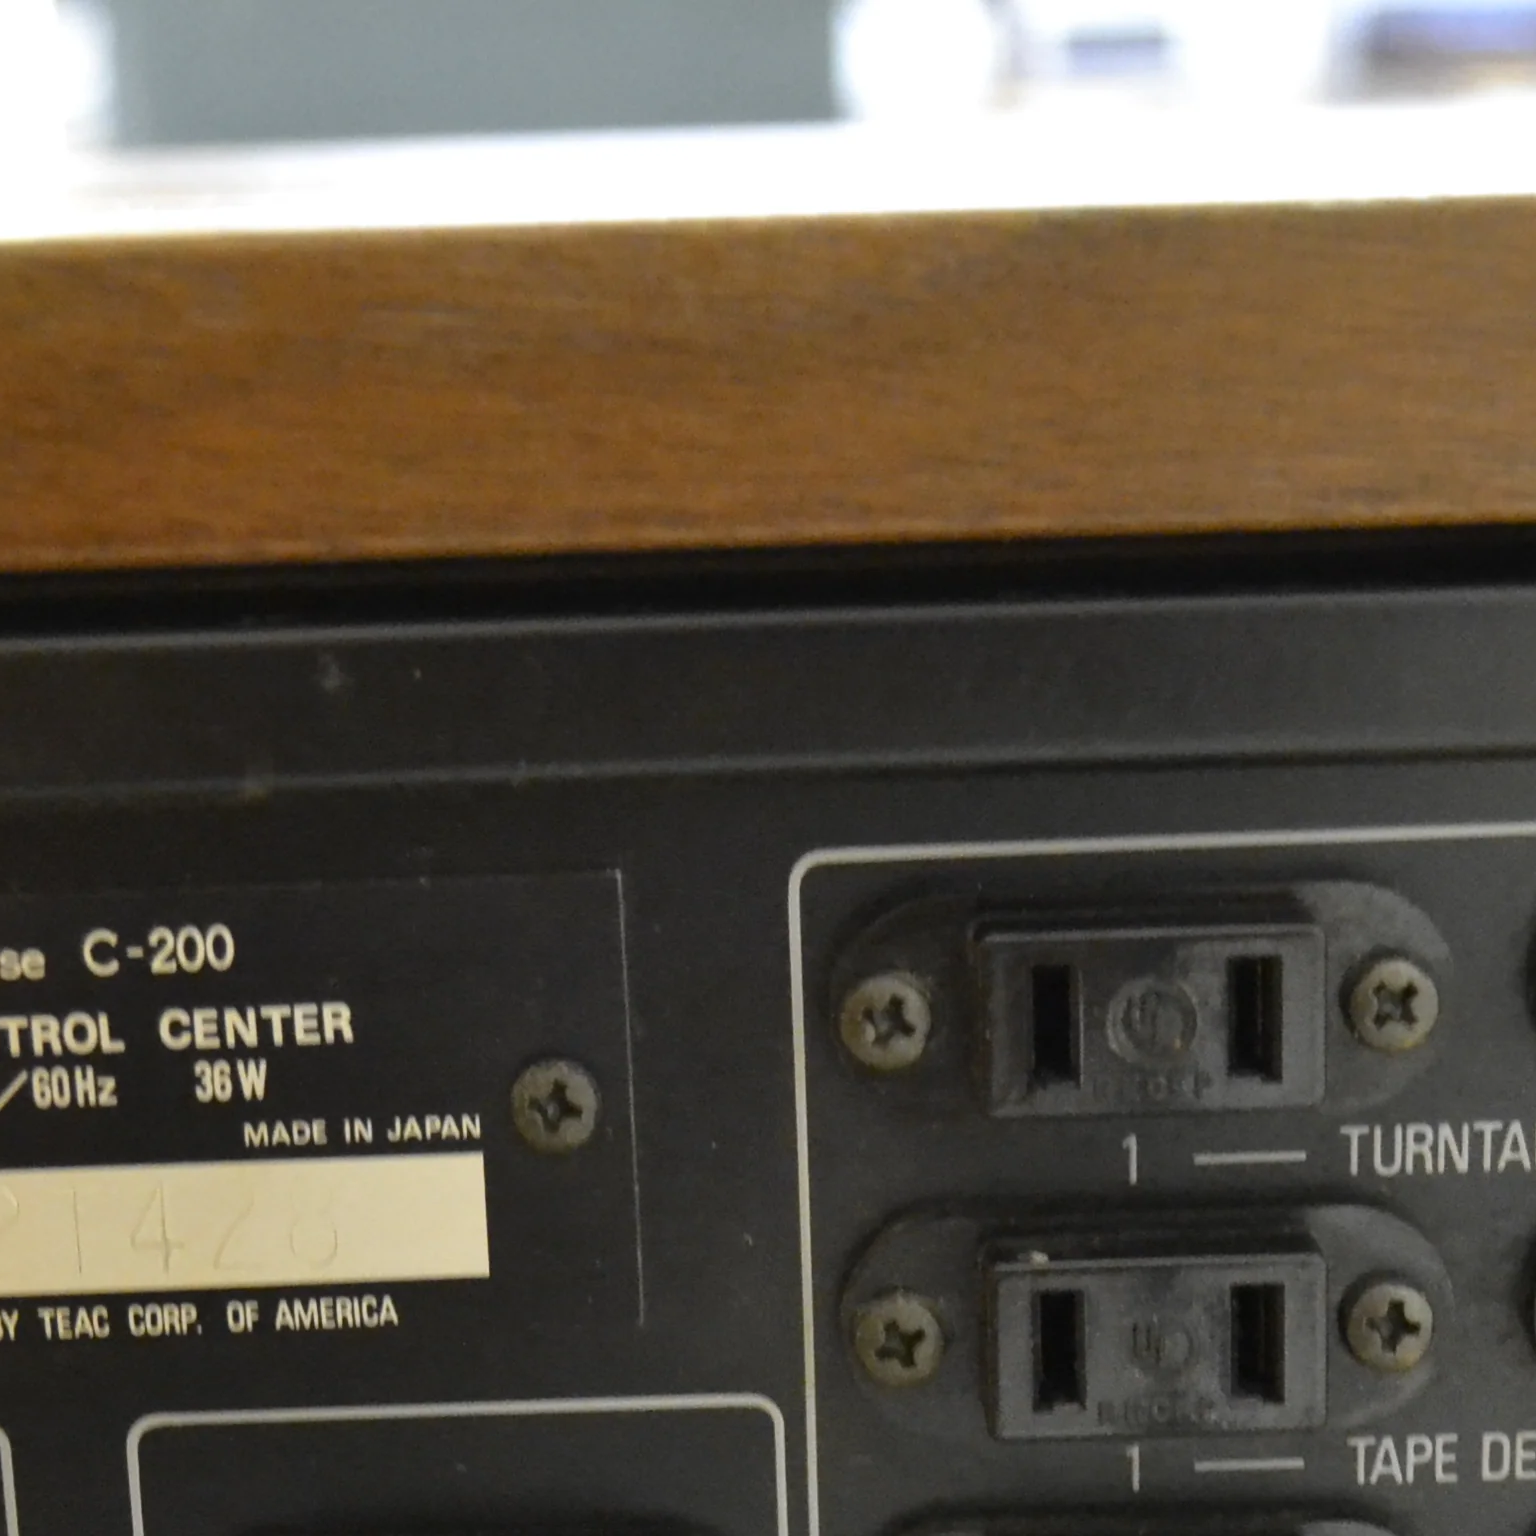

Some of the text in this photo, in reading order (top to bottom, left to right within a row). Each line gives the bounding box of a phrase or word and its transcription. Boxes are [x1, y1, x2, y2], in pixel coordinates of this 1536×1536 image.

[82, 923, 235, 977] C-200
[158, 1001, 354, 1050] CENTER
[194, 1058, 267, 1102] 36W
[243, 1113, 482, 1147] MADE IN JAPAN
[1122, 1133, 1138, 1184] 1
[37, 1305, 111, 1340] TEAC
[128, 1302, 203, 1337] CORP.
[226, 1300, 259, 1333] OF
[274, 1294, 399, 1330] AMERICA
[1125, 1443, 1141, 1491] 1
[1349, 1432, 1458, 1485] TAPE
